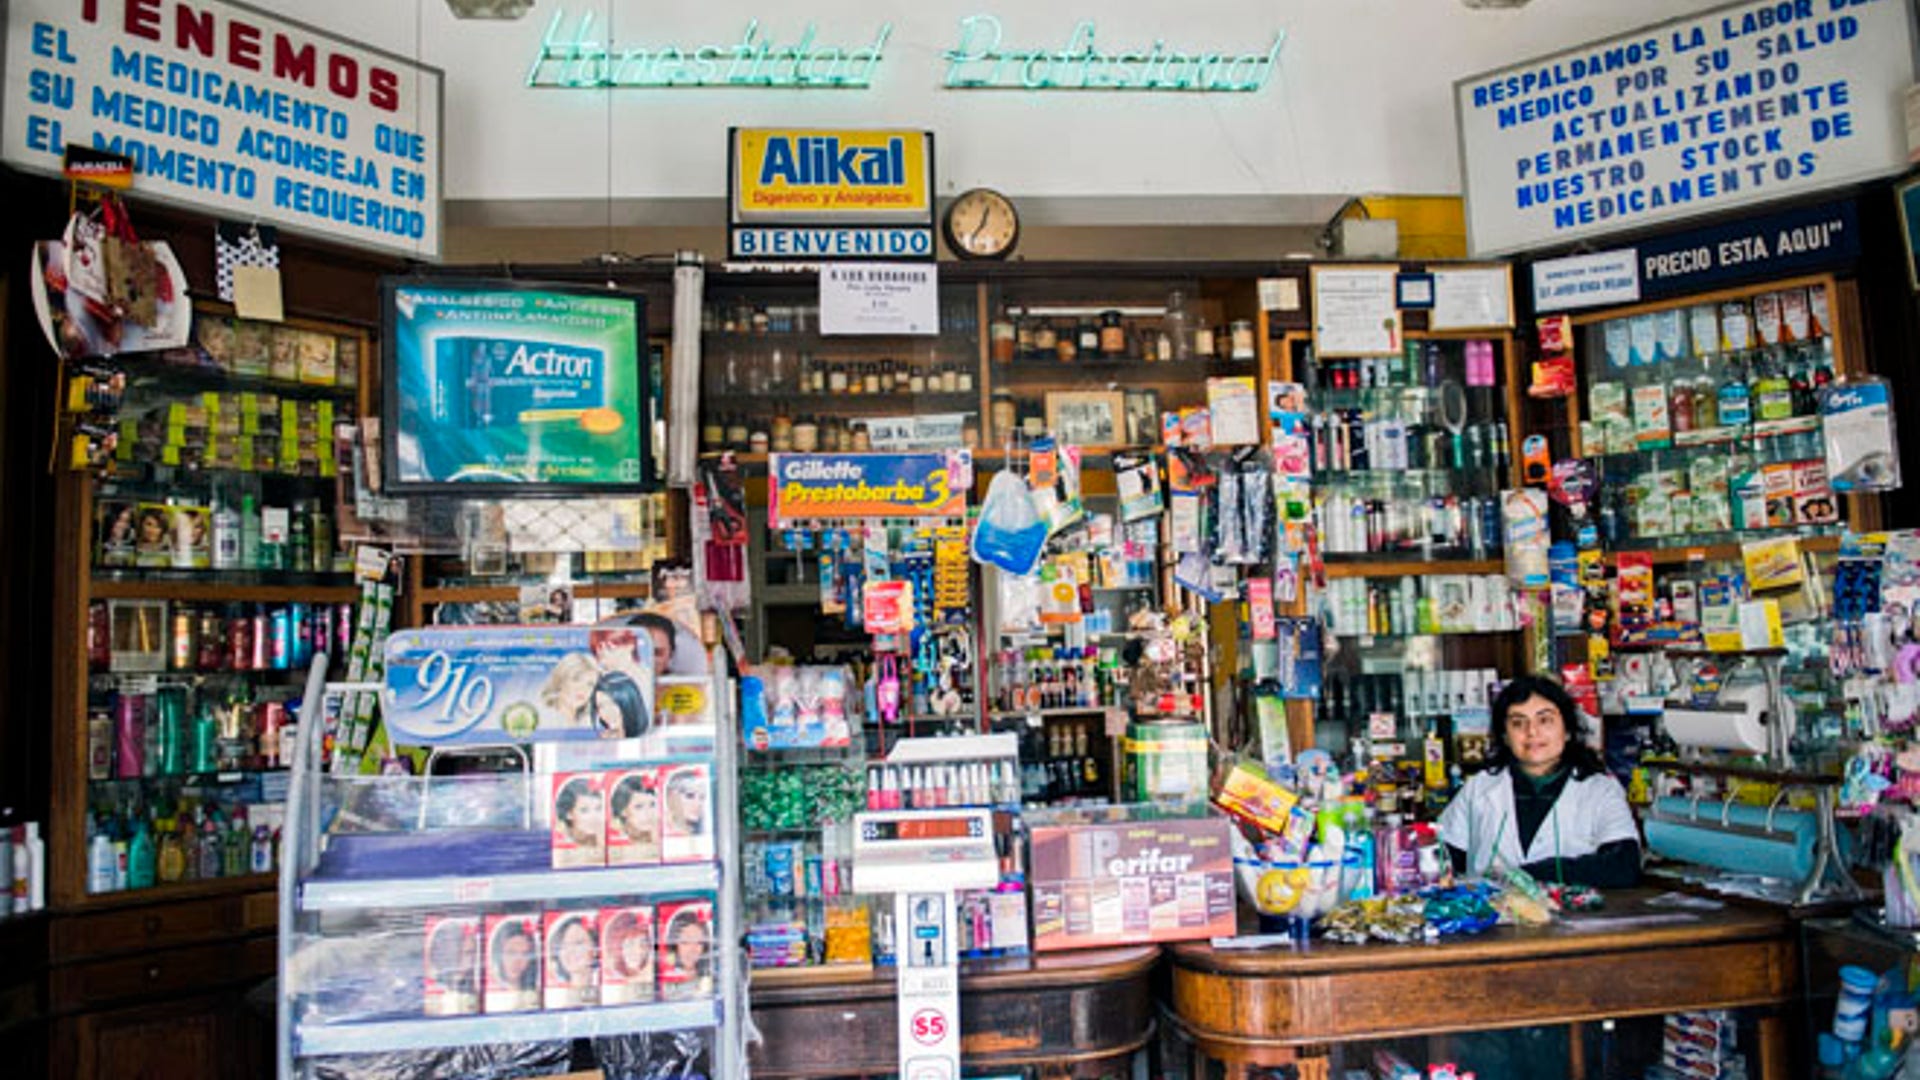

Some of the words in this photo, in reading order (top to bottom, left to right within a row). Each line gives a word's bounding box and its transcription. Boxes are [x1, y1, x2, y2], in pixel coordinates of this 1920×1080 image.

[530, 7, 893, 88] Honestidad
[1473, 39, 1659, 107] RESPALDAMOS
[1672, 27, 1706, 54] LA
[1723, 0, 1813, 41] LABOR
[1498, 86, 1594, 129] MEDICO
[1616, 66, 1668, 97] POR
[1695, 49, 1730, 76] SU
[1757, 16, 1859, 61] SALUD
[31, 22, 77, 64] EL
[111, 45, 348, 140] MEDICAMENTO
[375, 123, 425, 163] QUE
[1516, 81, 1849, 181] PERMANENTEMENTE
[1552, 62, 1800, 143] ACTUALIZANDO
[29, 69, 75, 110] SU
[91, 85, 220, 147] MEDICO
[237, 127, 379, 188] ACONSEJA
[392, 169, 425, 201] EN
[760, 136, 905, 186] Alikal
[1516, 160, 1645, 208] NUESTRO
[1681, 129, 1781, 171] STOCK
[1811, 112, 1853, 142] DE
[26, 115, 66, 156] EL
[92, 131, 256, 199] MOMENTO
[273, 176, 425, 240] REQUERIDO
[753, 189, 818, 206] Digestivo
[822, 194, 831, 206] y
[1554, 152, 1816, 230] MEDICAMENTOS
[740, 231, 929, 254] BIENVENIDO
[1645, 249, 1711, 279] PRECIO
[1719, 238, 1769, 266] ESTA
[503, 343, 592, 378] Actron
[784, 459, 863, 480] Gillette
[785, 479, 925, 503] Prestobarba
[409, 649, 494, 738] 919
